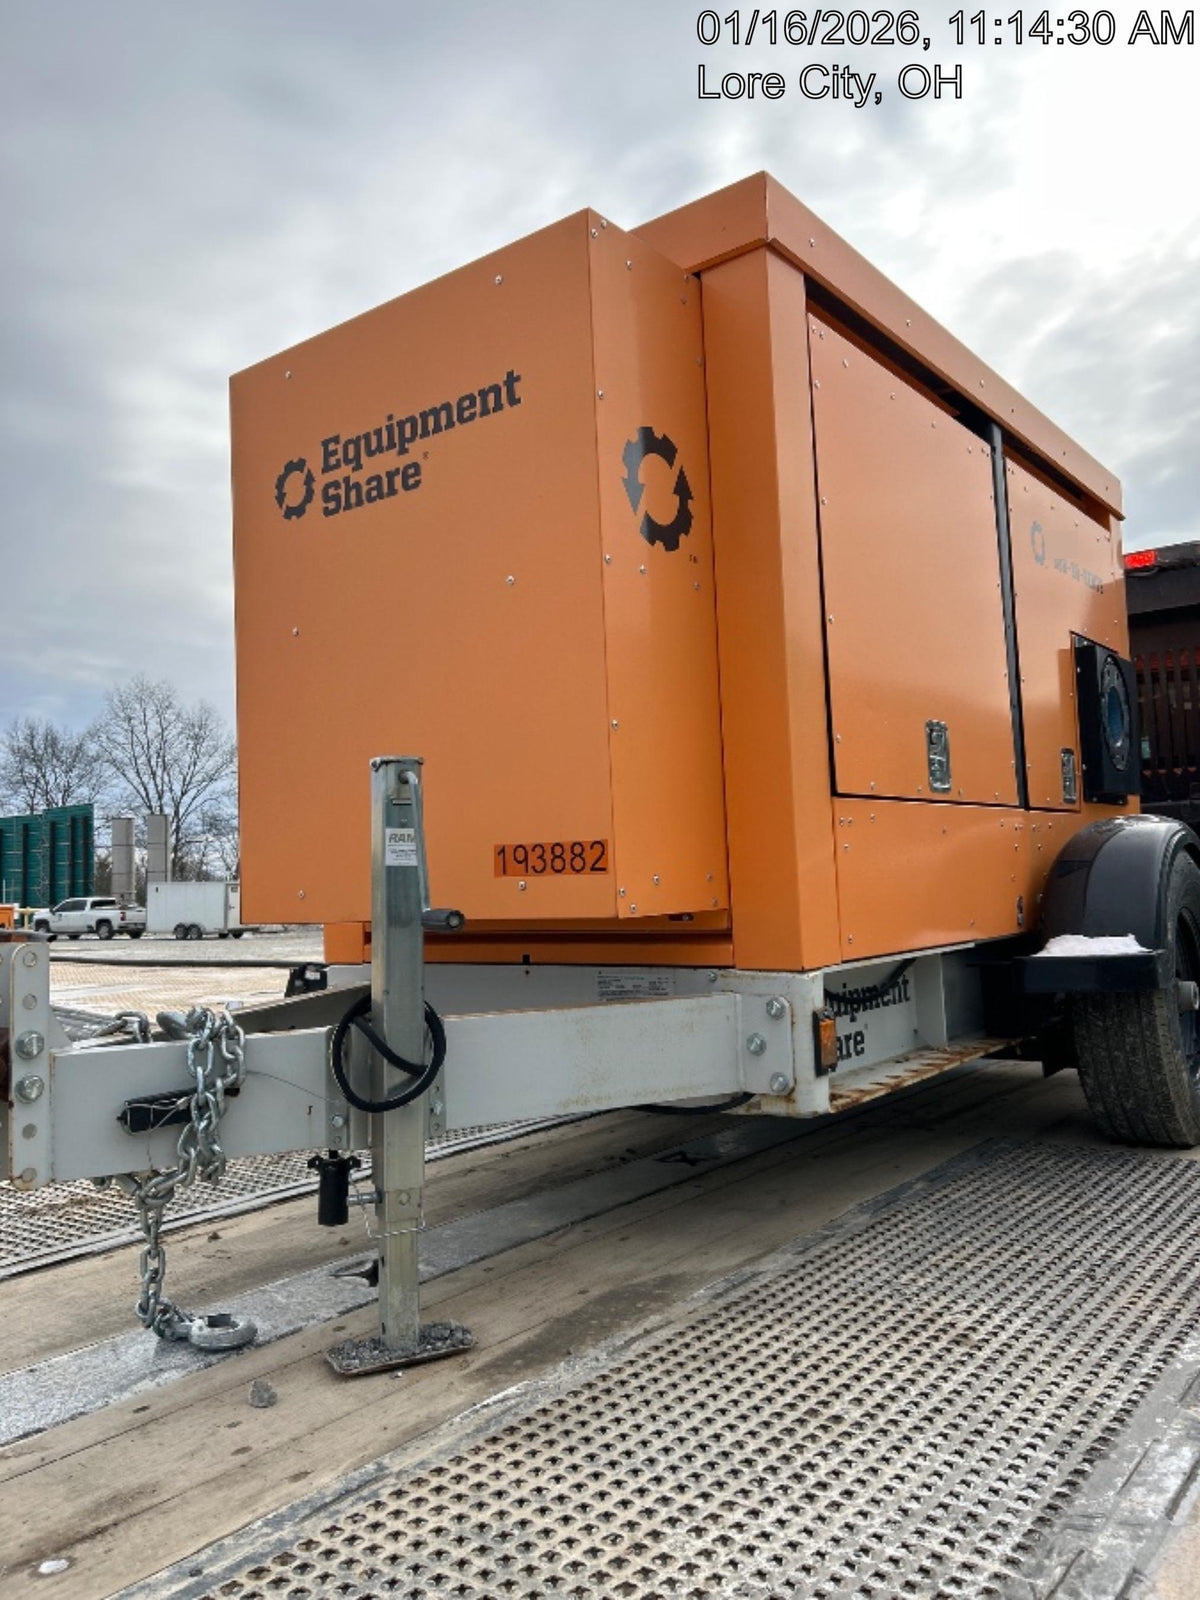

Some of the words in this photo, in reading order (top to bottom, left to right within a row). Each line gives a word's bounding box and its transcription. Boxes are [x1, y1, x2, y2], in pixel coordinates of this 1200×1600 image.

[321, 370, 521, 473] Equipment
[322, 461, 422, 517] Share
[497, 841, 607, 875] 193882
